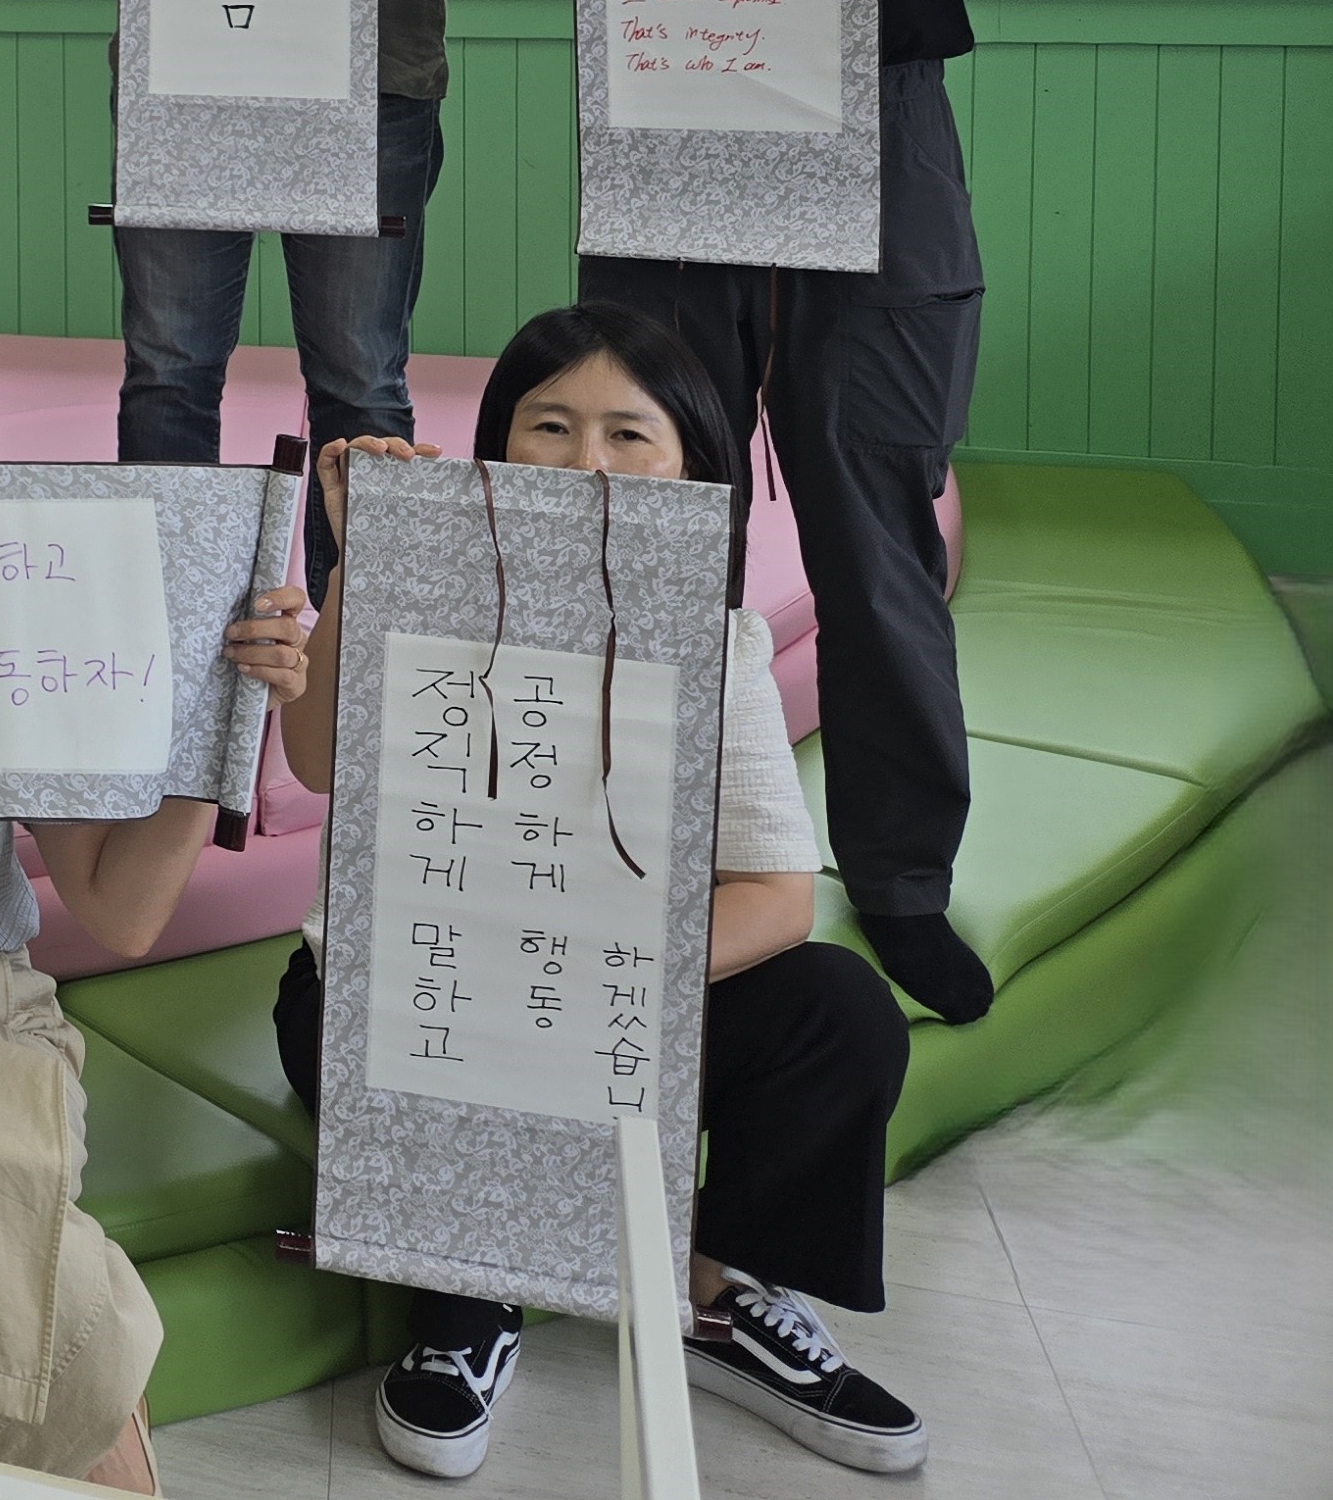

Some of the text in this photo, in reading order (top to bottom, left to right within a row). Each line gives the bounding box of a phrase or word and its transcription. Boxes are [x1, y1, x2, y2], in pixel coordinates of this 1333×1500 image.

[620, 15, 669, 43] That's
[625, 51, 671, 72] That's
[684, 54, 714, 72] who
[720, 57, 738, 73] I
[408, 667, 484, 1064] 정직하게 말하고
[509, 673, 575, 1030] 공정하게 행동
[593, 945, 655, 1118] 하겠습니
